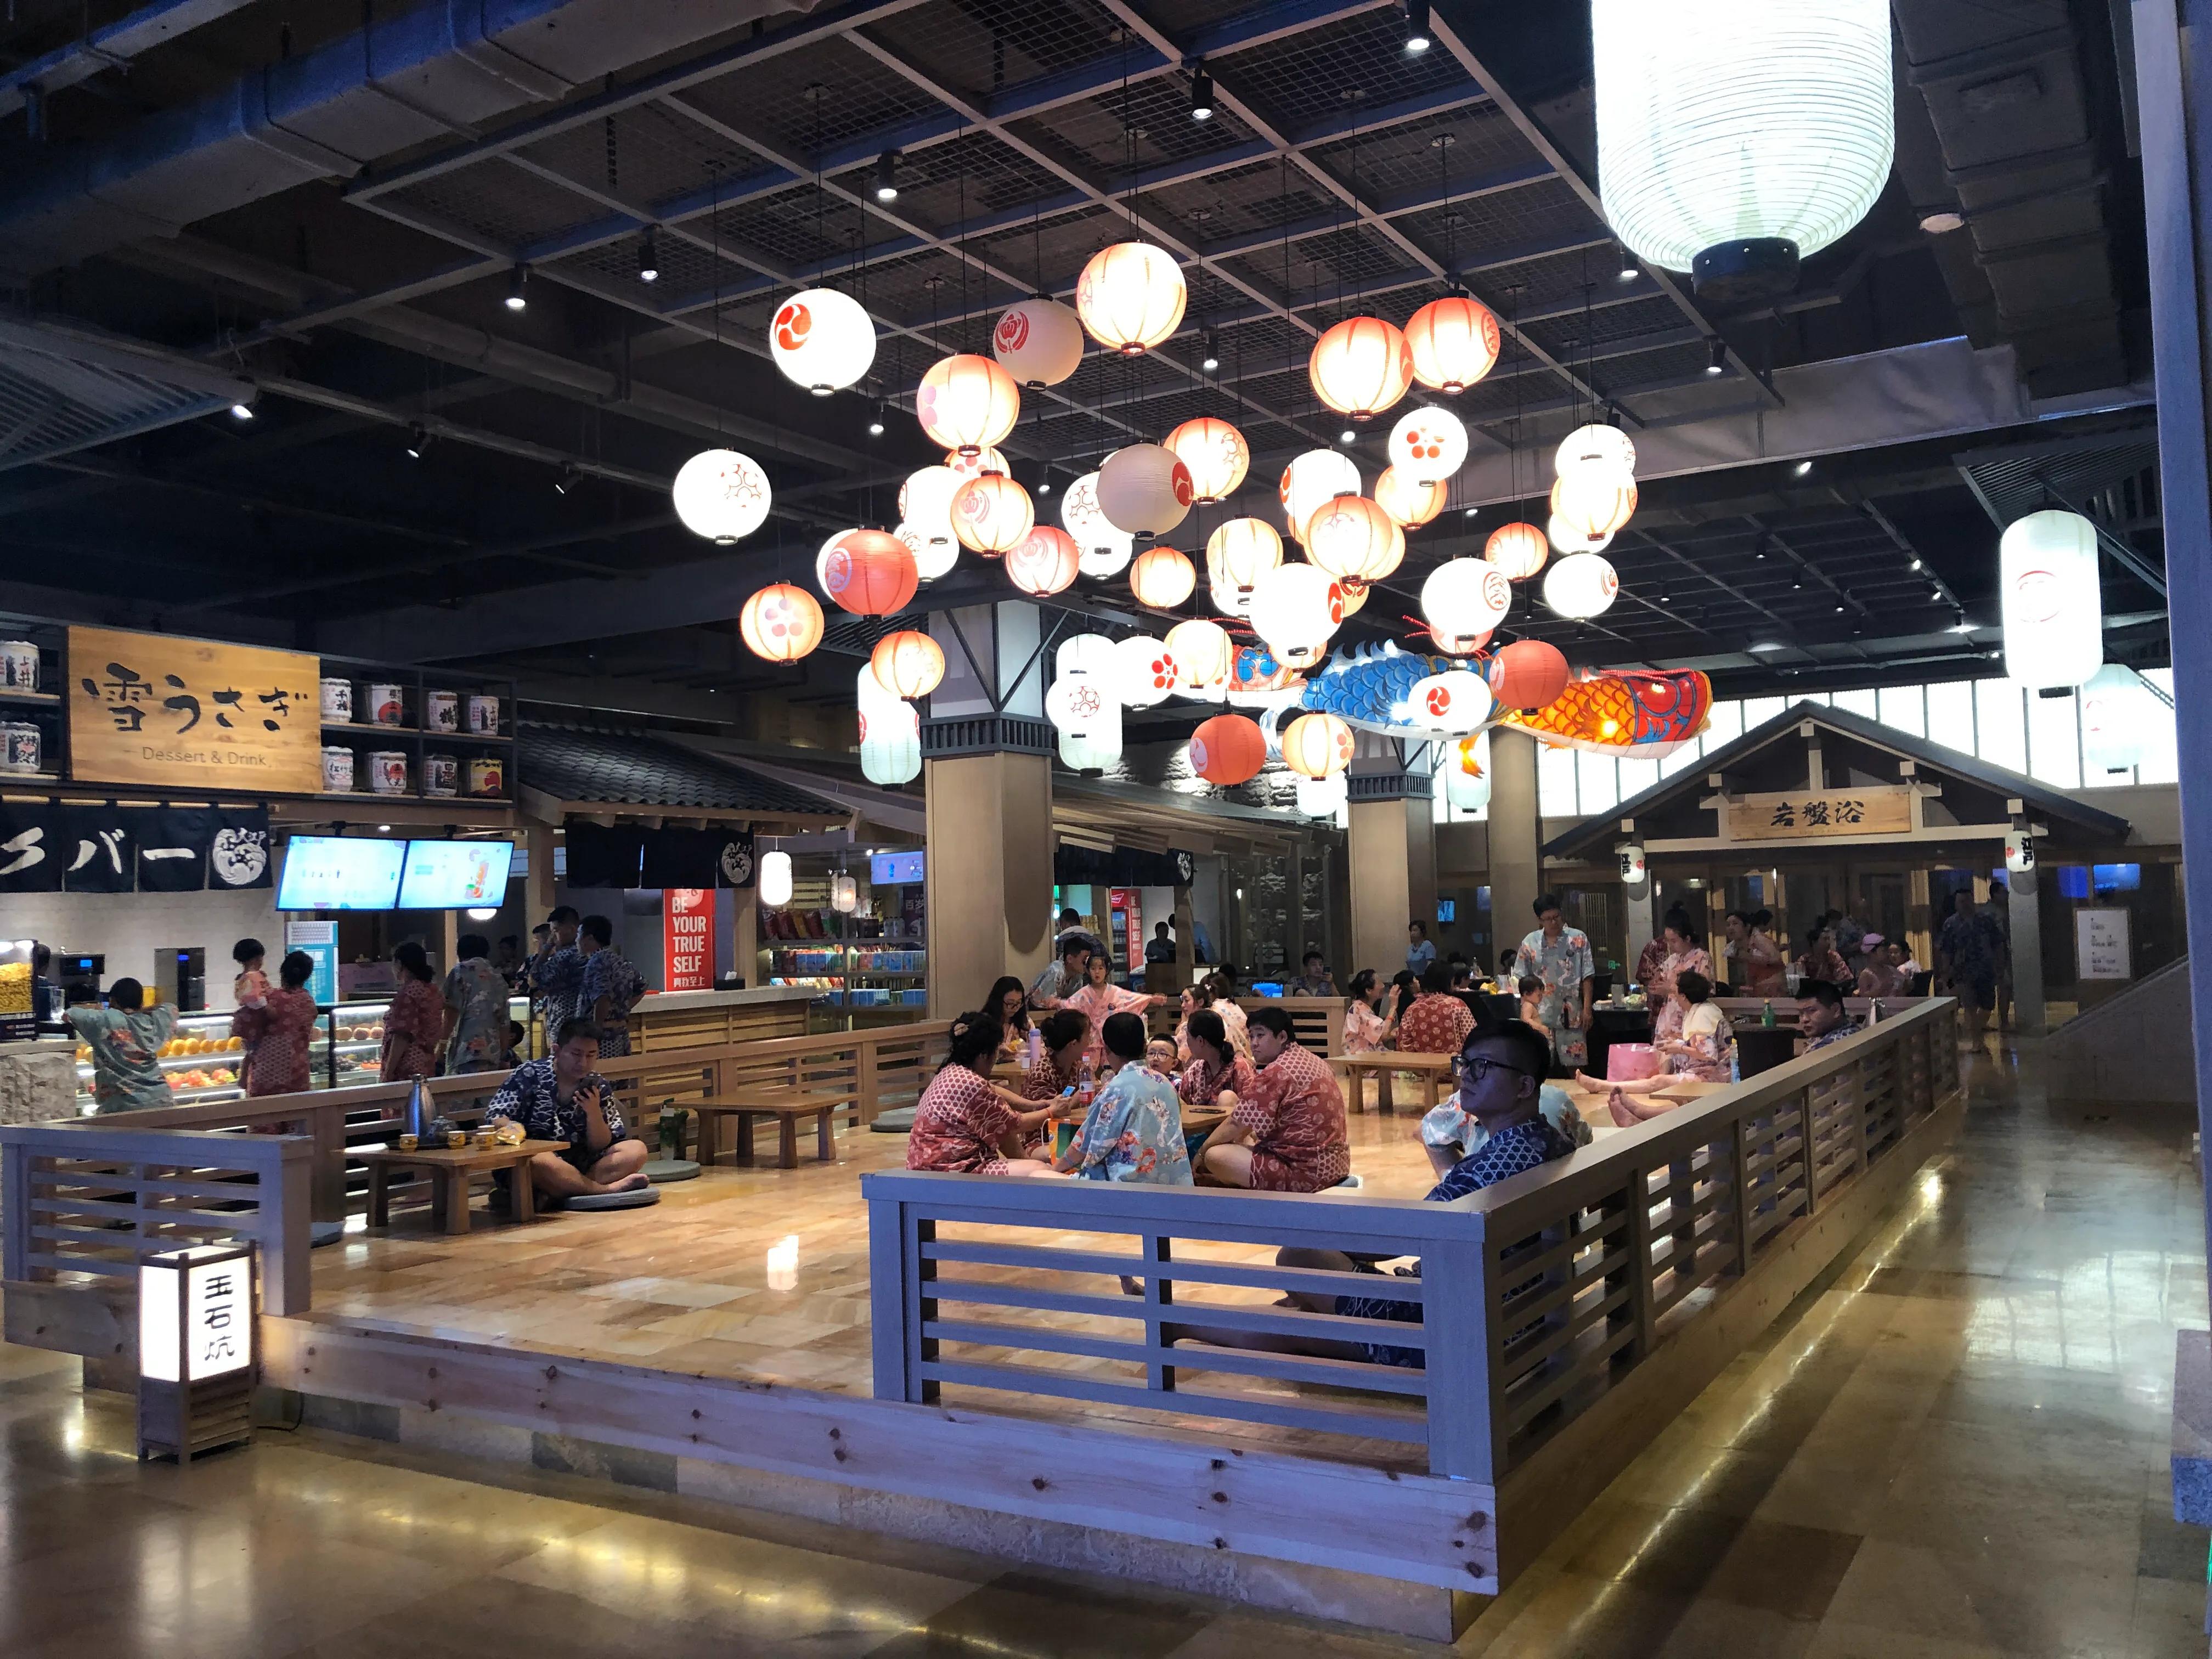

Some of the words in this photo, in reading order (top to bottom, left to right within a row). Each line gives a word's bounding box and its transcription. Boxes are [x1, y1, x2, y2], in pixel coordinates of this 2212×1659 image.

[82, 662, 308, 734] 雪うさぎ
[143, 747, 206, 763] Dessert
[211, 751, 223, 764] &
[228, 752, 266, 765] Drink
[672, 897, 688, 913] BE
[673, 916, 706, 933] YOUR
[1132, 919, 1141, 929] TRUE
[673, 935, 705, 952] TRUE
[1132, 931, 1141, 941] SELF
[674, 956, 702, 973] SELF
